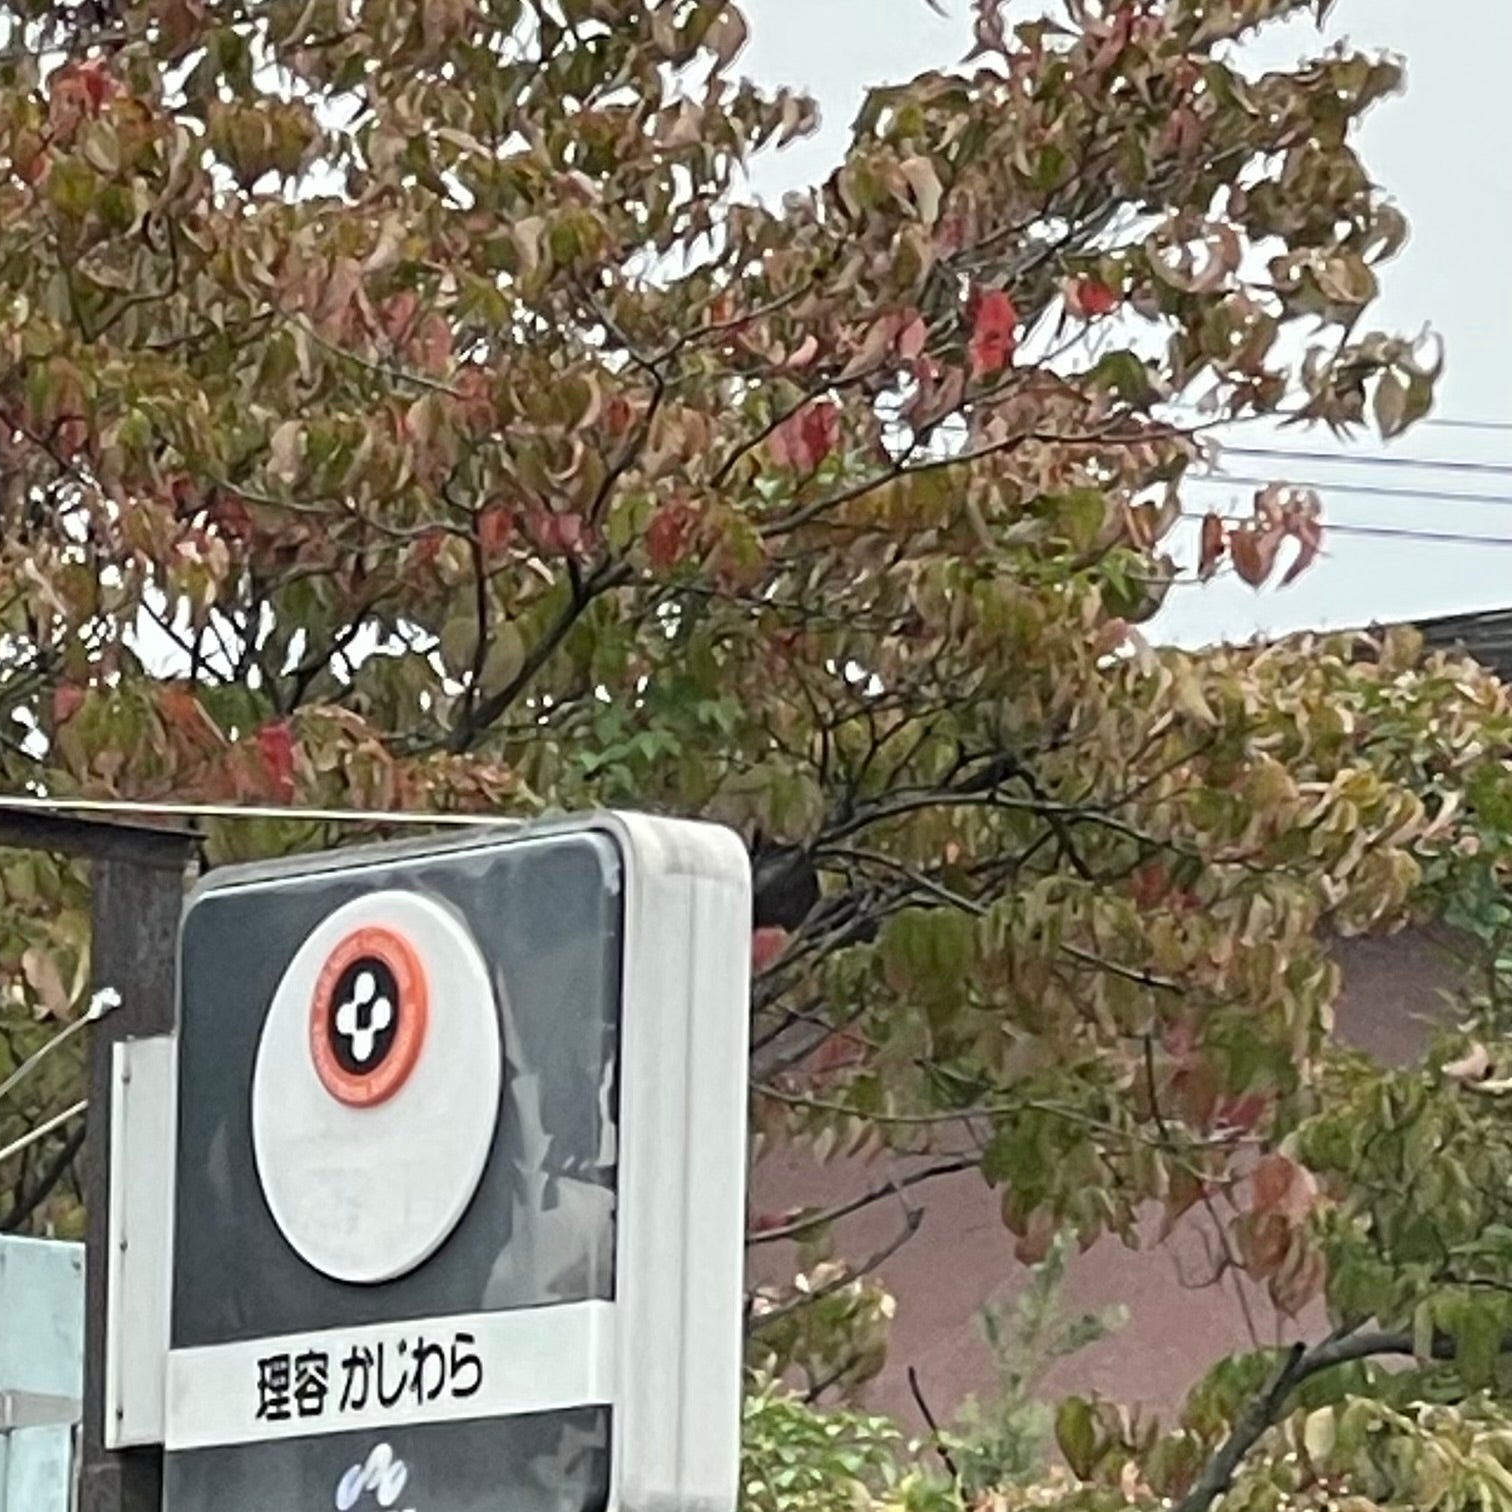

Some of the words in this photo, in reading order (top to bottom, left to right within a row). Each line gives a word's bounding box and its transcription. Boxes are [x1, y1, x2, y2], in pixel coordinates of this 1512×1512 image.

[255, 1332, 483, 1421] 理容かじわら
